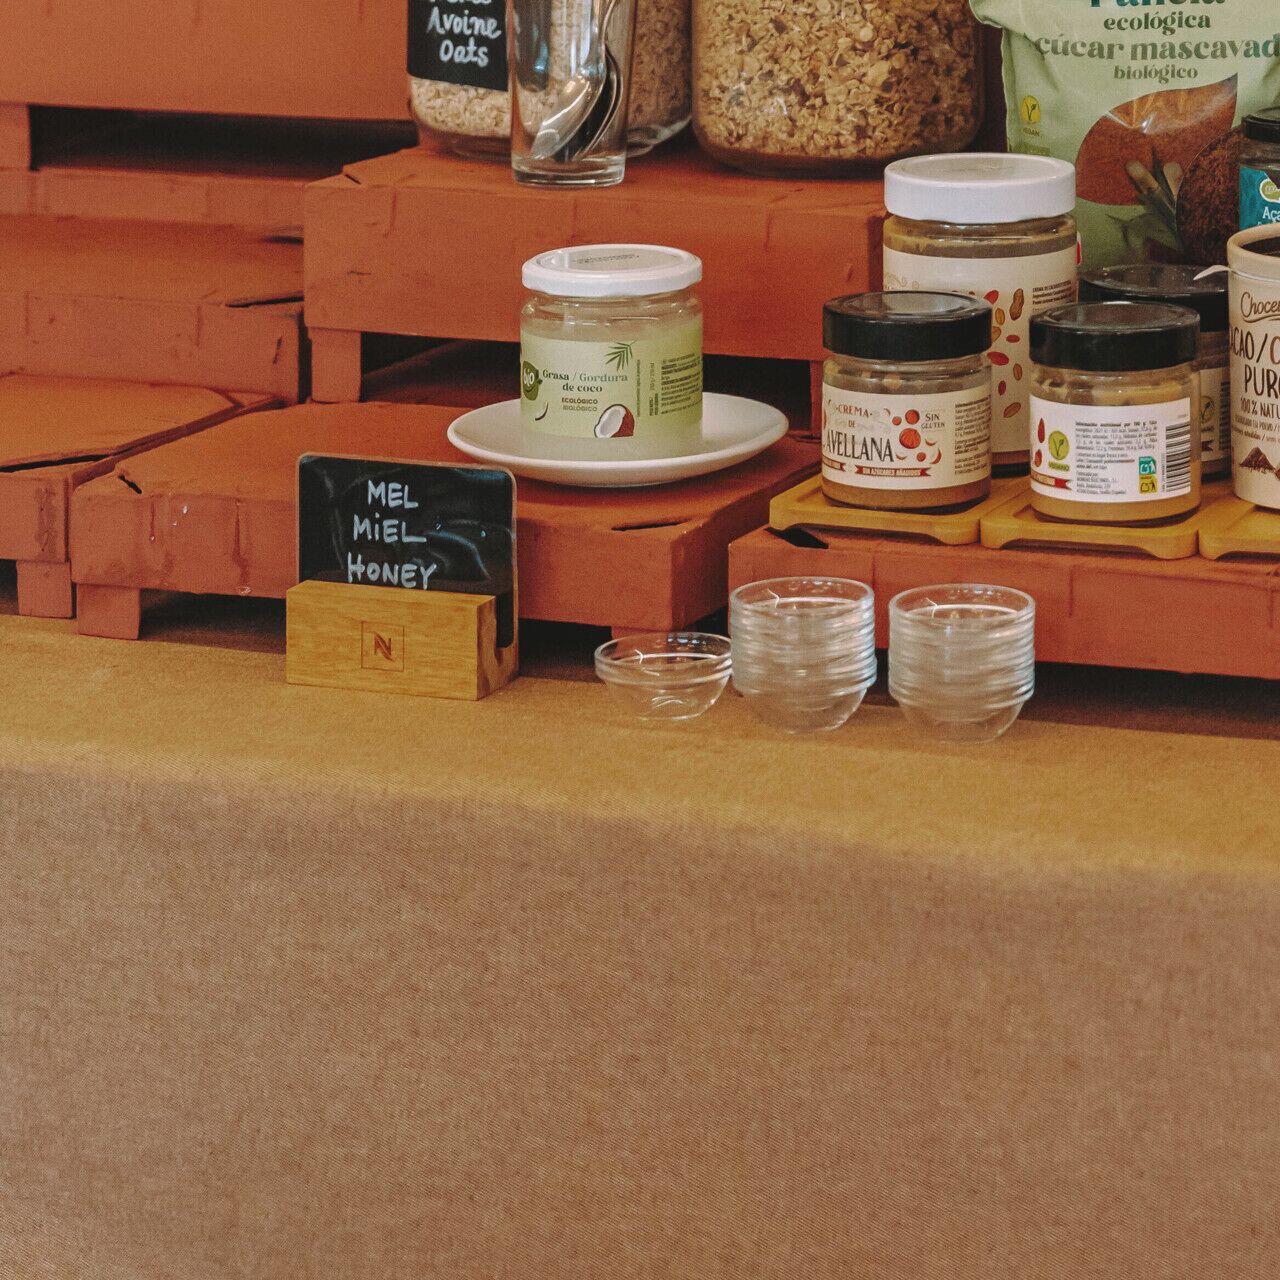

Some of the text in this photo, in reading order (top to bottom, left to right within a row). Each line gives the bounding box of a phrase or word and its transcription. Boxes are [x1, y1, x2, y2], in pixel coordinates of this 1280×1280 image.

[427, 7, 501, 39] Avoine
[1103, 11, 1211, 36] ecológica
[439, 37, 489, 68] Oats
[1113, 64, 1199, 85] biológico
[562, 383, 574, 391] de
[838, 404, 869, 418] CREMA
[925, 413, 940, 422] SIN
[826, 430, 894, 462] AVELLANA
[368, 480, 419, 509] MEL
[347, 552, 437, 590] HONEY
